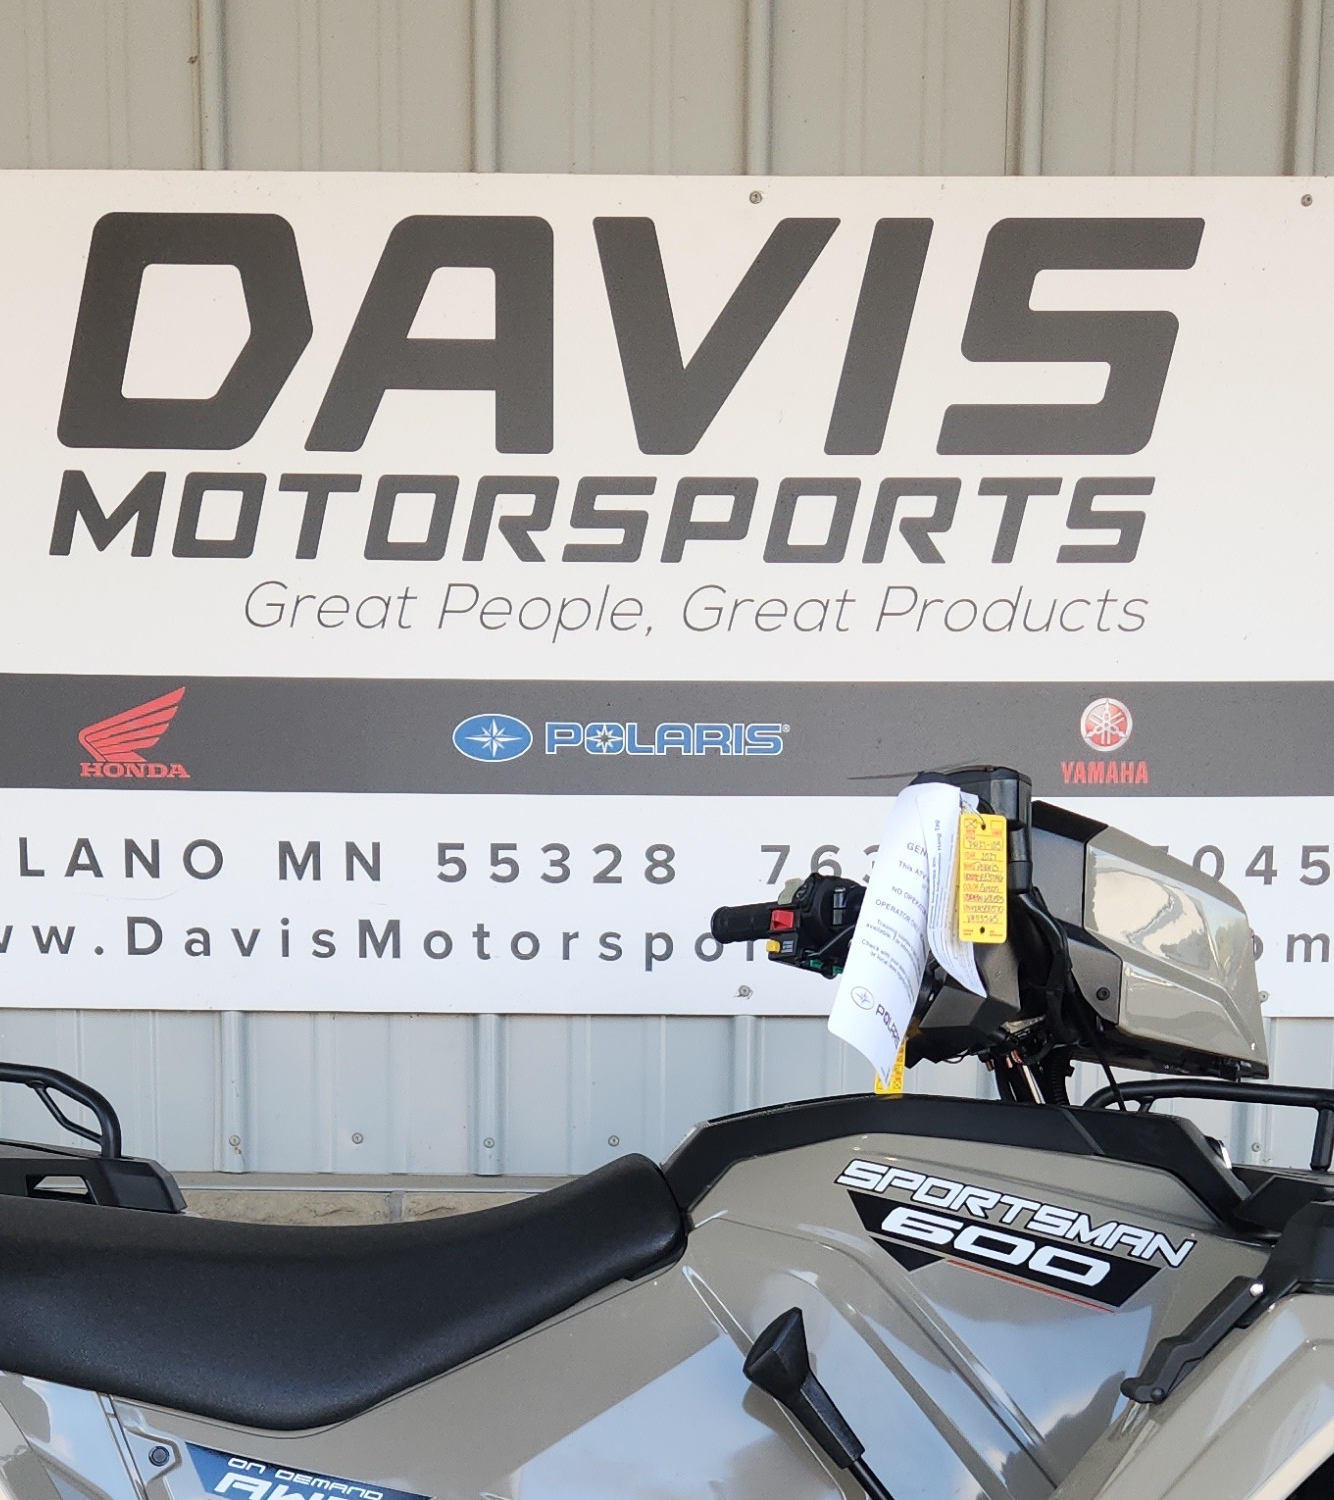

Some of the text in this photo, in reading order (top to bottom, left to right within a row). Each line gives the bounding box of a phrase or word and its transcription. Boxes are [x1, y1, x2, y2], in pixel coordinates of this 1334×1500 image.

[56, 211, 1206, 456] DAVIS
[48, 469, 1156, 564] MOTORSPORTS
[244, 580, 1149, 645] Great People, Great Products
[80, 762, 191, 778] HONDA
[545, 721, 785, 756] POLARIS
[1061, 760, 1149, 784] YAMAHA
[278, 840, 381, 882] MN
[437, 842, 676, 885] 55328
[836, 1159, 1195, 1268] SPORTSMAN
[880, 1206, 1112, 1287] 600
